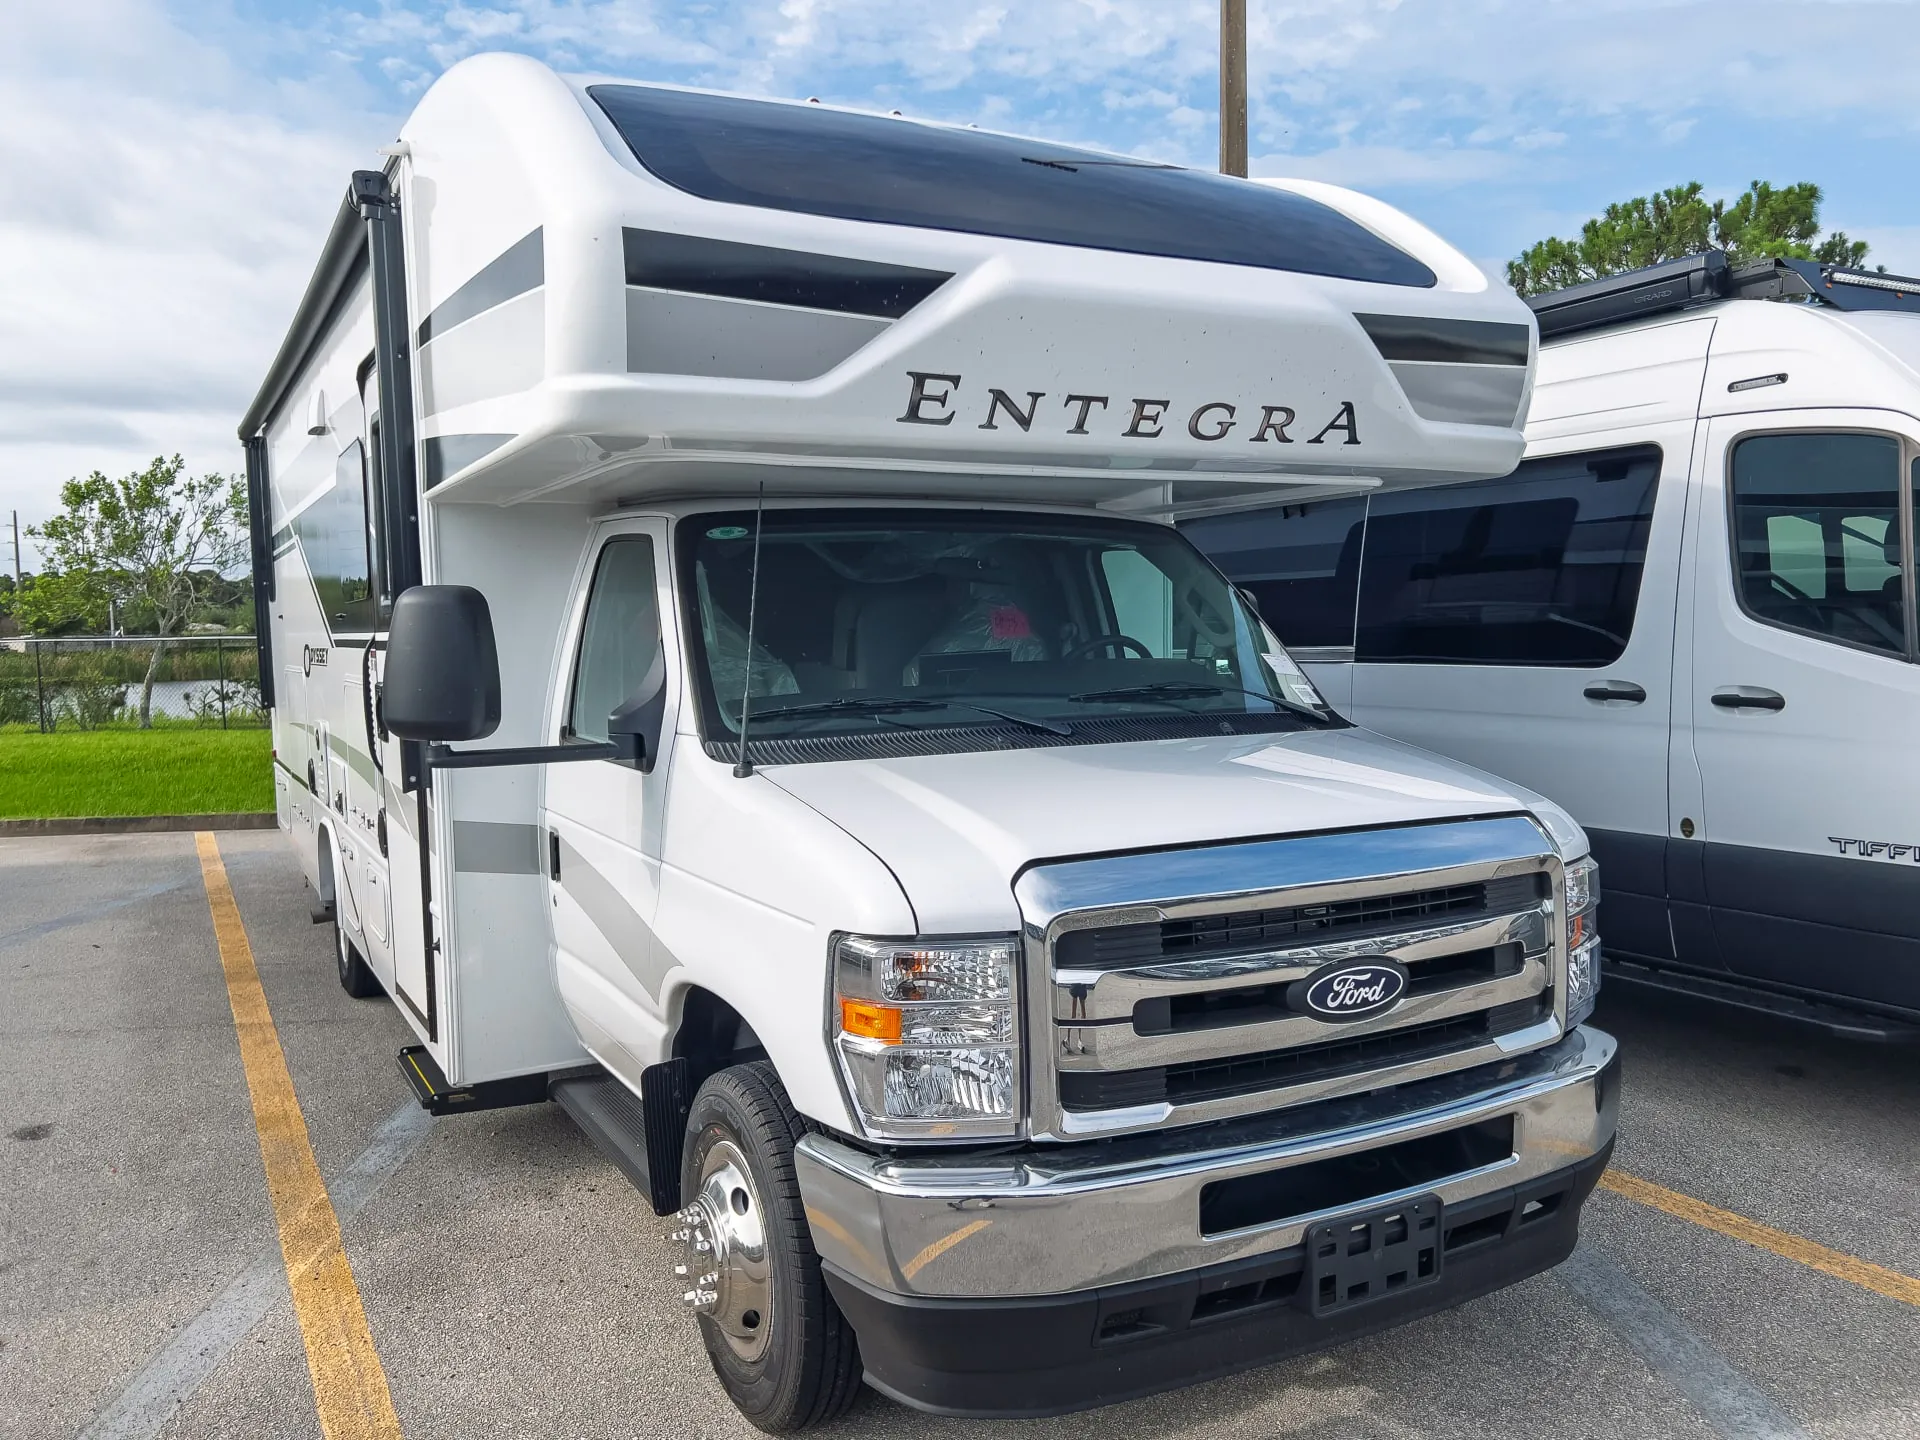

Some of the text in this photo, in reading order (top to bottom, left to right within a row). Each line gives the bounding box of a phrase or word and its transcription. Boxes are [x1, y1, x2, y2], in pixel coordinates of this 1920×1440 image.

[895, 370, 1363, 446] ENTEGRA
[303, 643, 329, 678] ODYSSEY
[1326, 972, 1386, 1008] Ford
